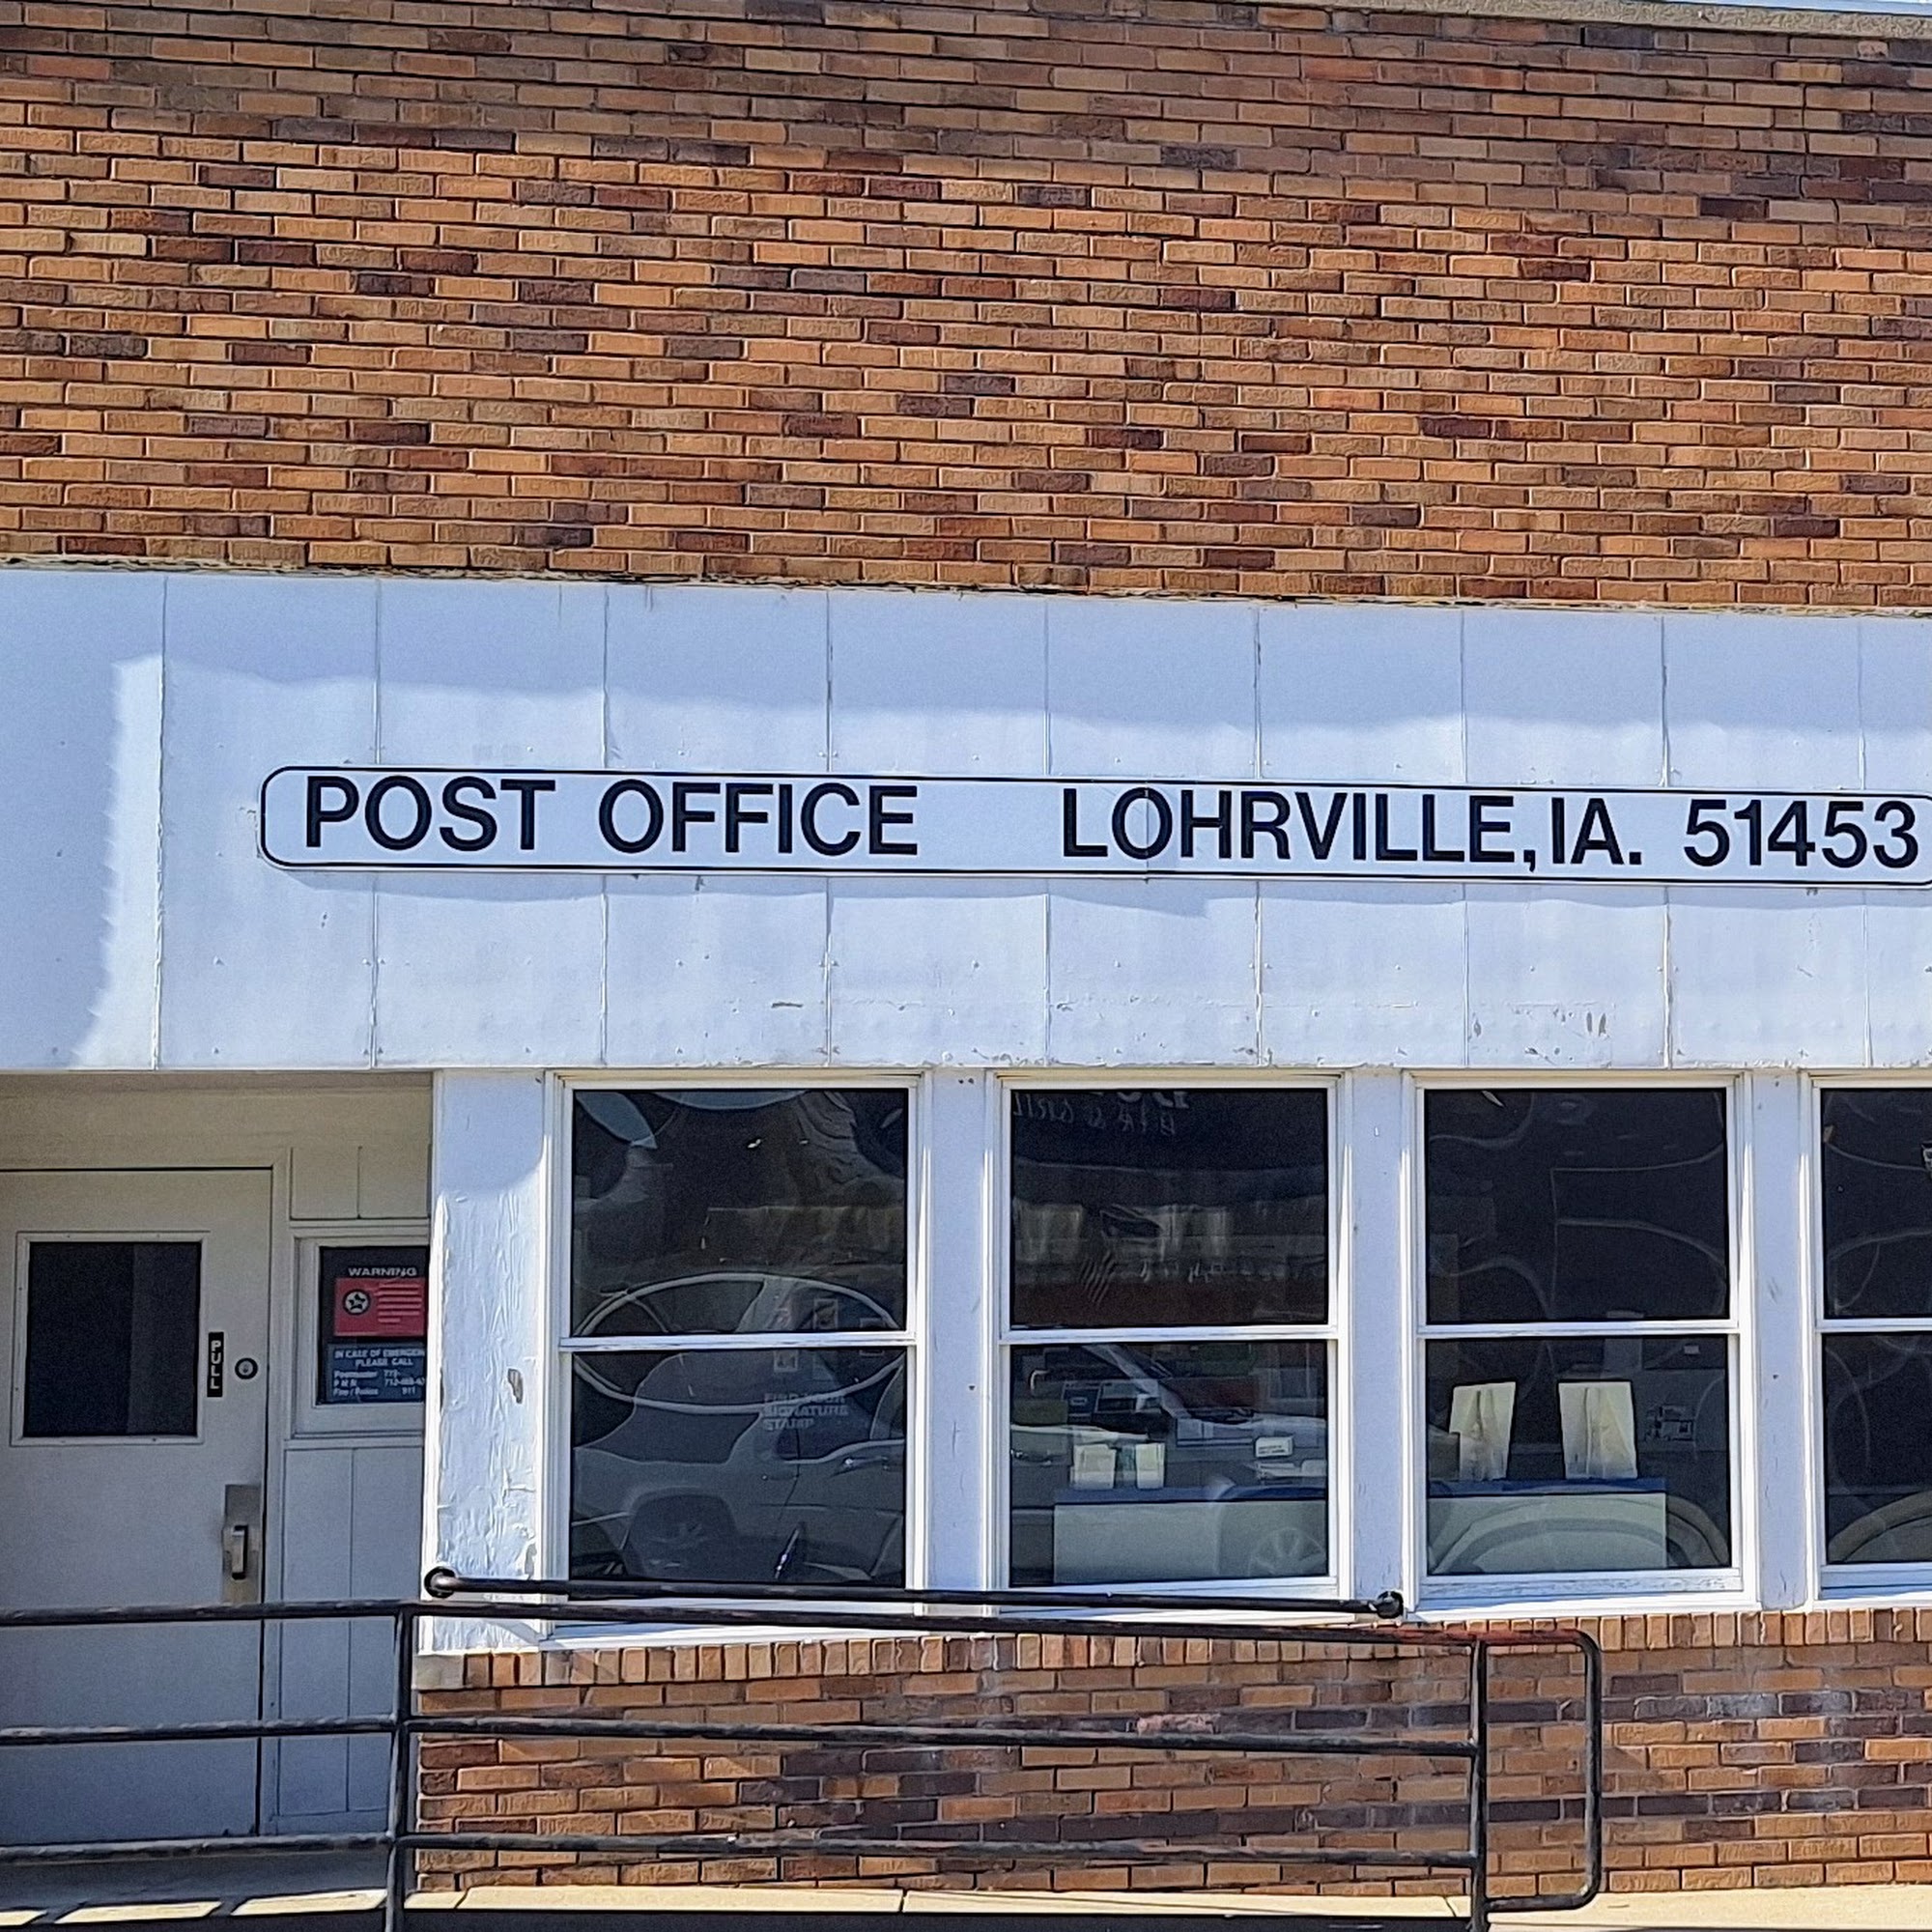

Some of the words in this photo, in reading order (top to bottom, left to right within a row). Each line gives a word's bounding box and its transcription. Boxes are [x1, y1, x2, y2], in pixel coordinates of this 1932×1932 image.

[306, 775, 556, 852] POST
[598, 779, 918, 857] OFFICE
[1684, 799, 1918, 868] 51453
[348, 1267, 417, 1277] WARNING
[210, 1340, 222, 1389] PULL
[391, 1357, 413, 1366] CALL
[762, 1417, 815, 1431] STAMP
